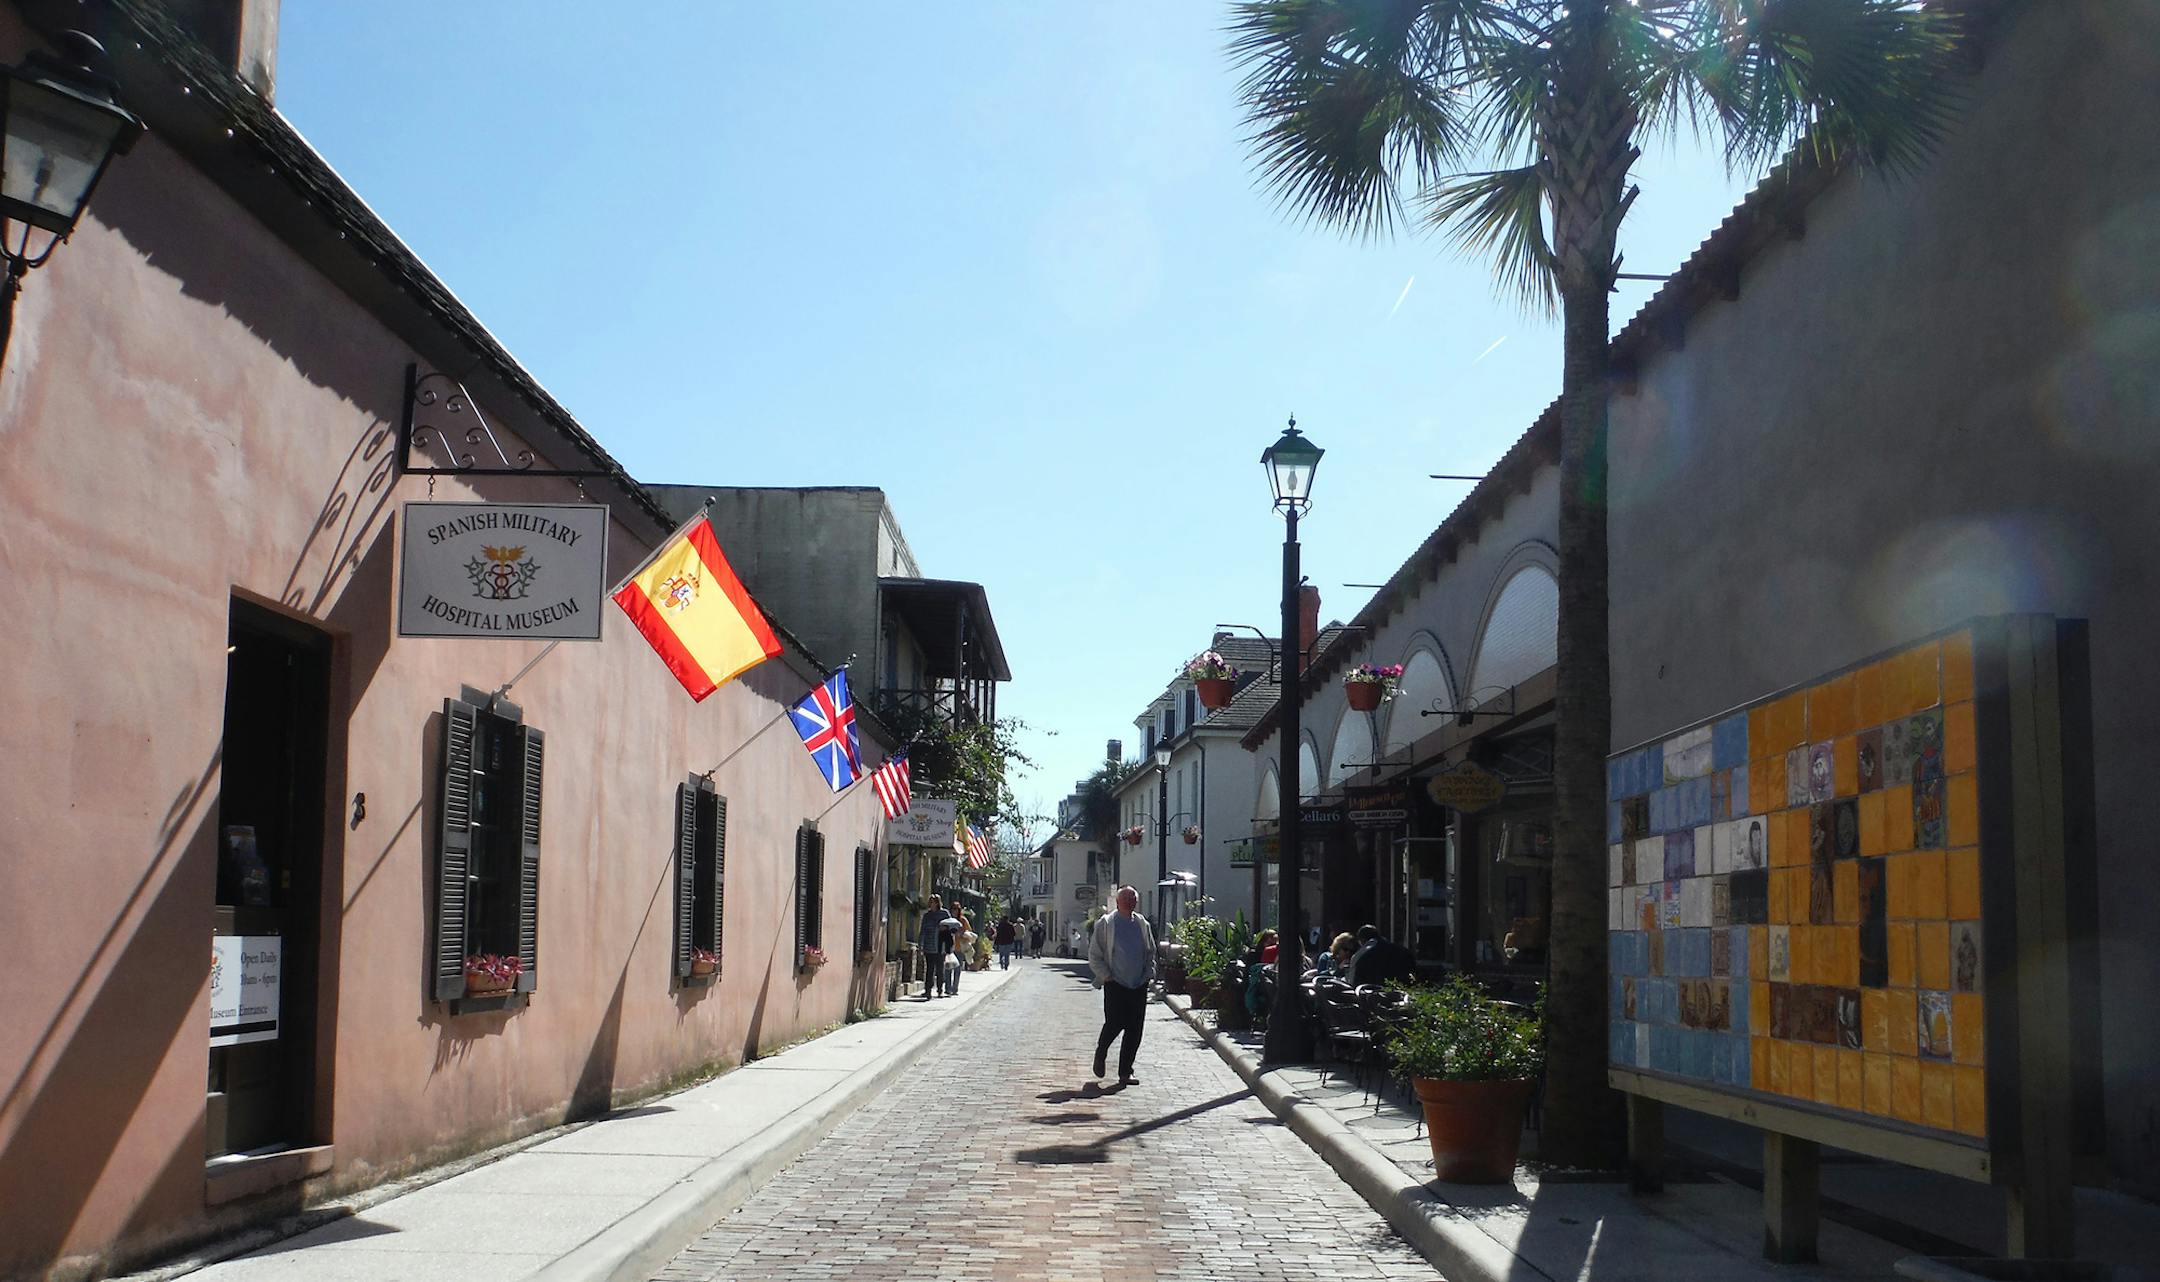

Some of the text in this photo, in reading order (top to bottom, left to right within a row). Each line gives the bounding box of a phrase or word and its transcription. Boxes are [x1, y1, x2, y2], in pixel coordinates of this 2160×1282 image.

[427, 512, 583, 548] SPANISH MILITARY
[421, 594, 580, 631] HOSPITAL MUSEUM
[240, 951, 259, 968] Open
[260, 951, 277, 965] Daily
[239, 1004, 267, 1016] Entrance
